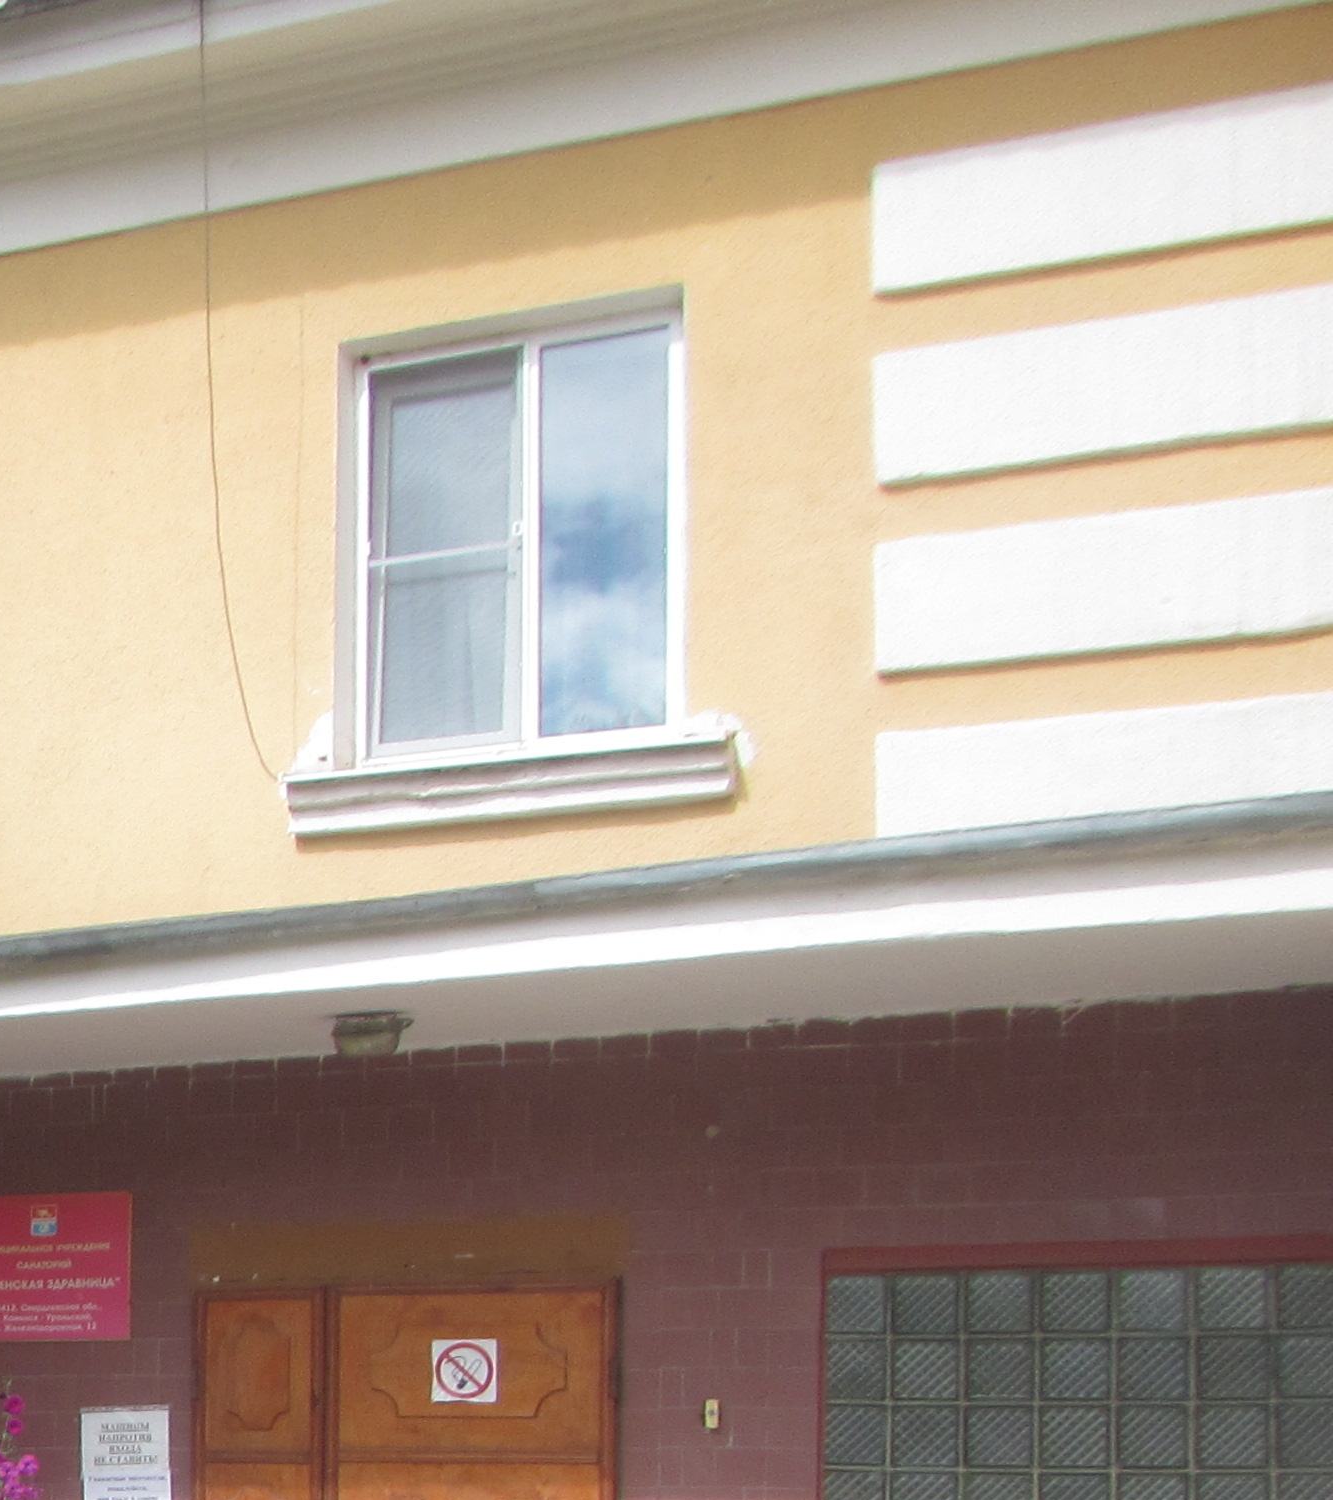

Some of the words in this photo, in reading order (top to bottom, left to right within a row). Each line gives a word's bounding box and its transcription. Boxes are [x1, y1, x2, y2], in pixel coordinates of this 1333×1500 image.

[16, 1259, 72, 1269] САНАТОРИЙ
[99, 1433, 153, 1443] НАПРОТИВ
[109, 1444, 142, 1454] ВХОДА
